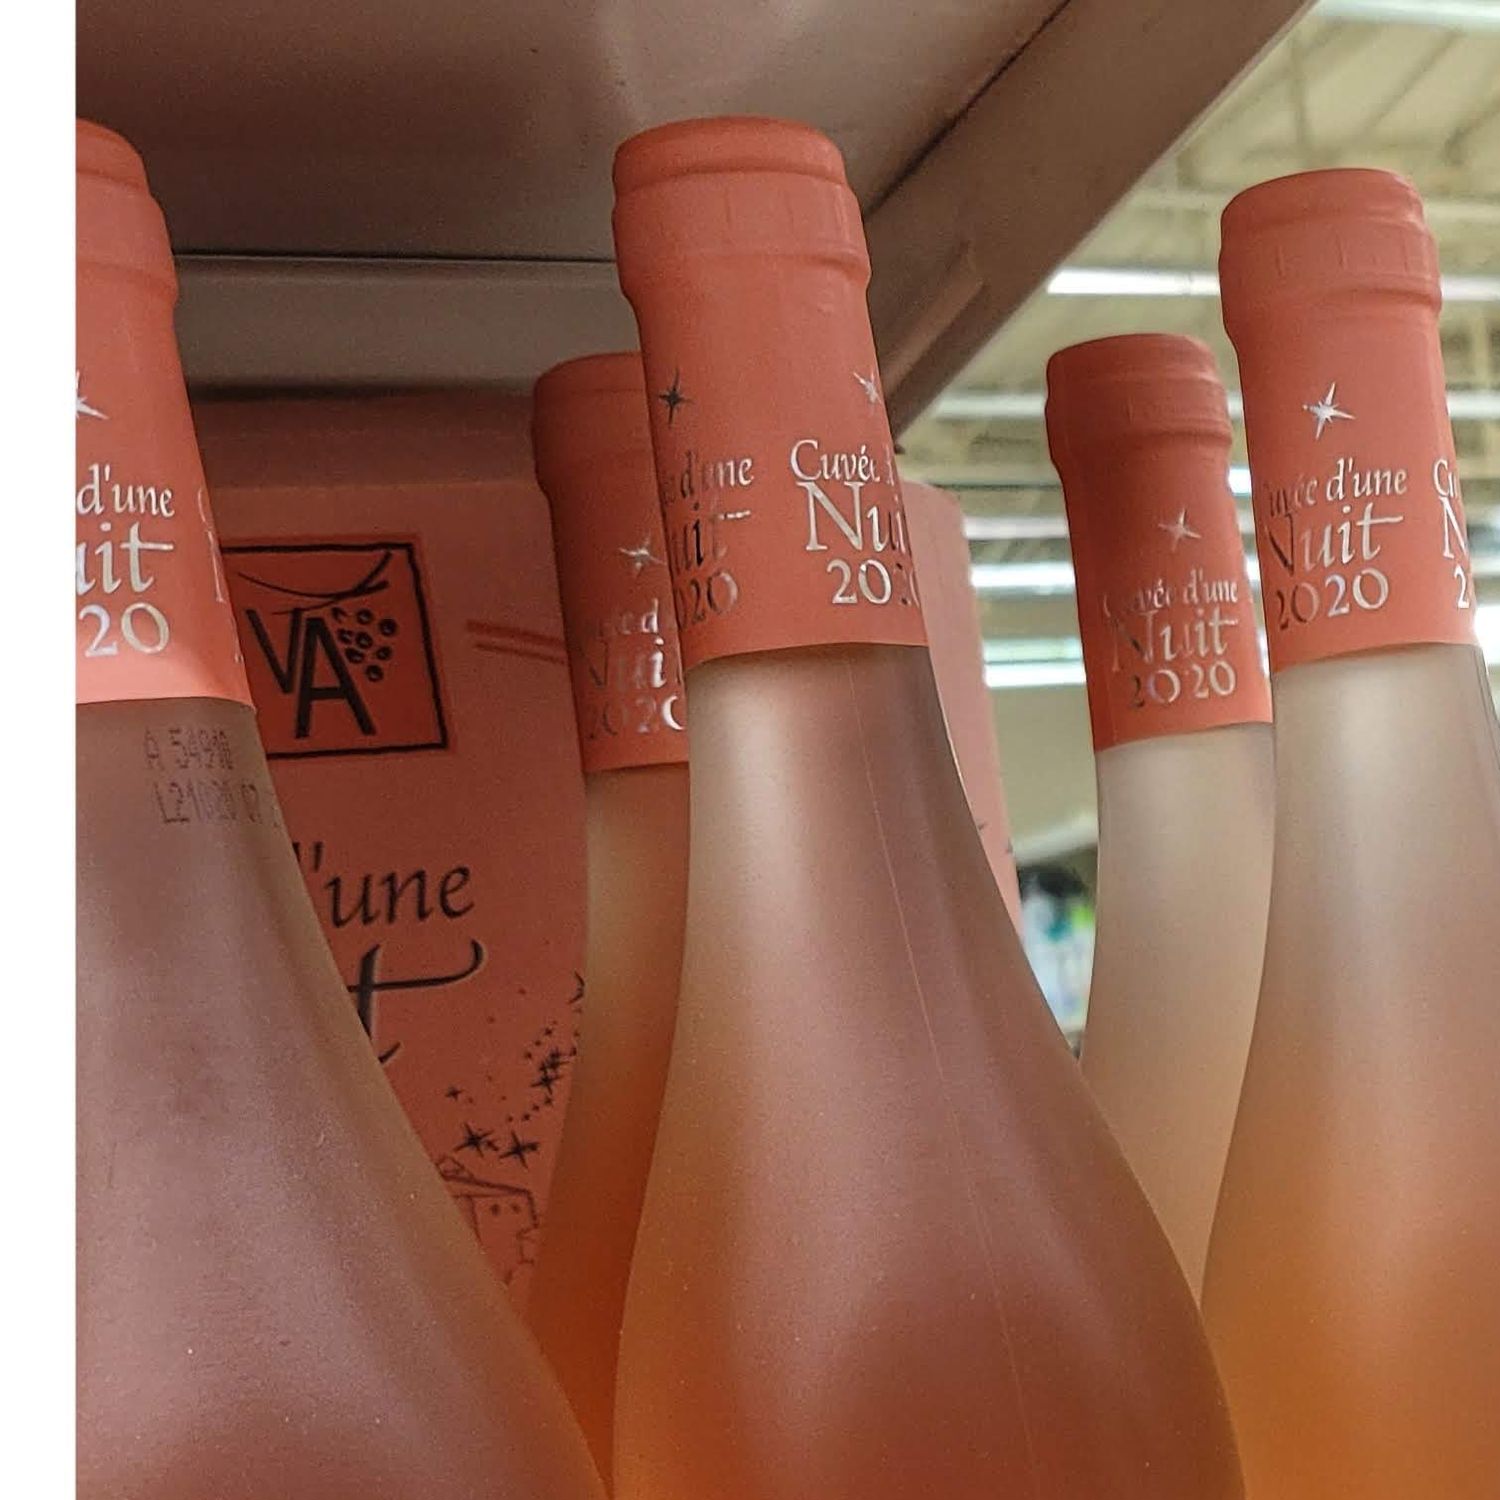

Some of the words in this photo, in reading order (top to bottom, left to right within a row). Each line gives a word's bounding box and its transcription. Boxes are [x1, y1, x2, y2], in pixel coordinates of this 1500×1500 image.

[76, 463, 175, 518] d'une
[1326, 457, 1407, 501] d'une
[1275, 567, 1390, 630] 2020
[1131, 660, 1236, 708] 2020
[293, 842, 475, 927] 'une
